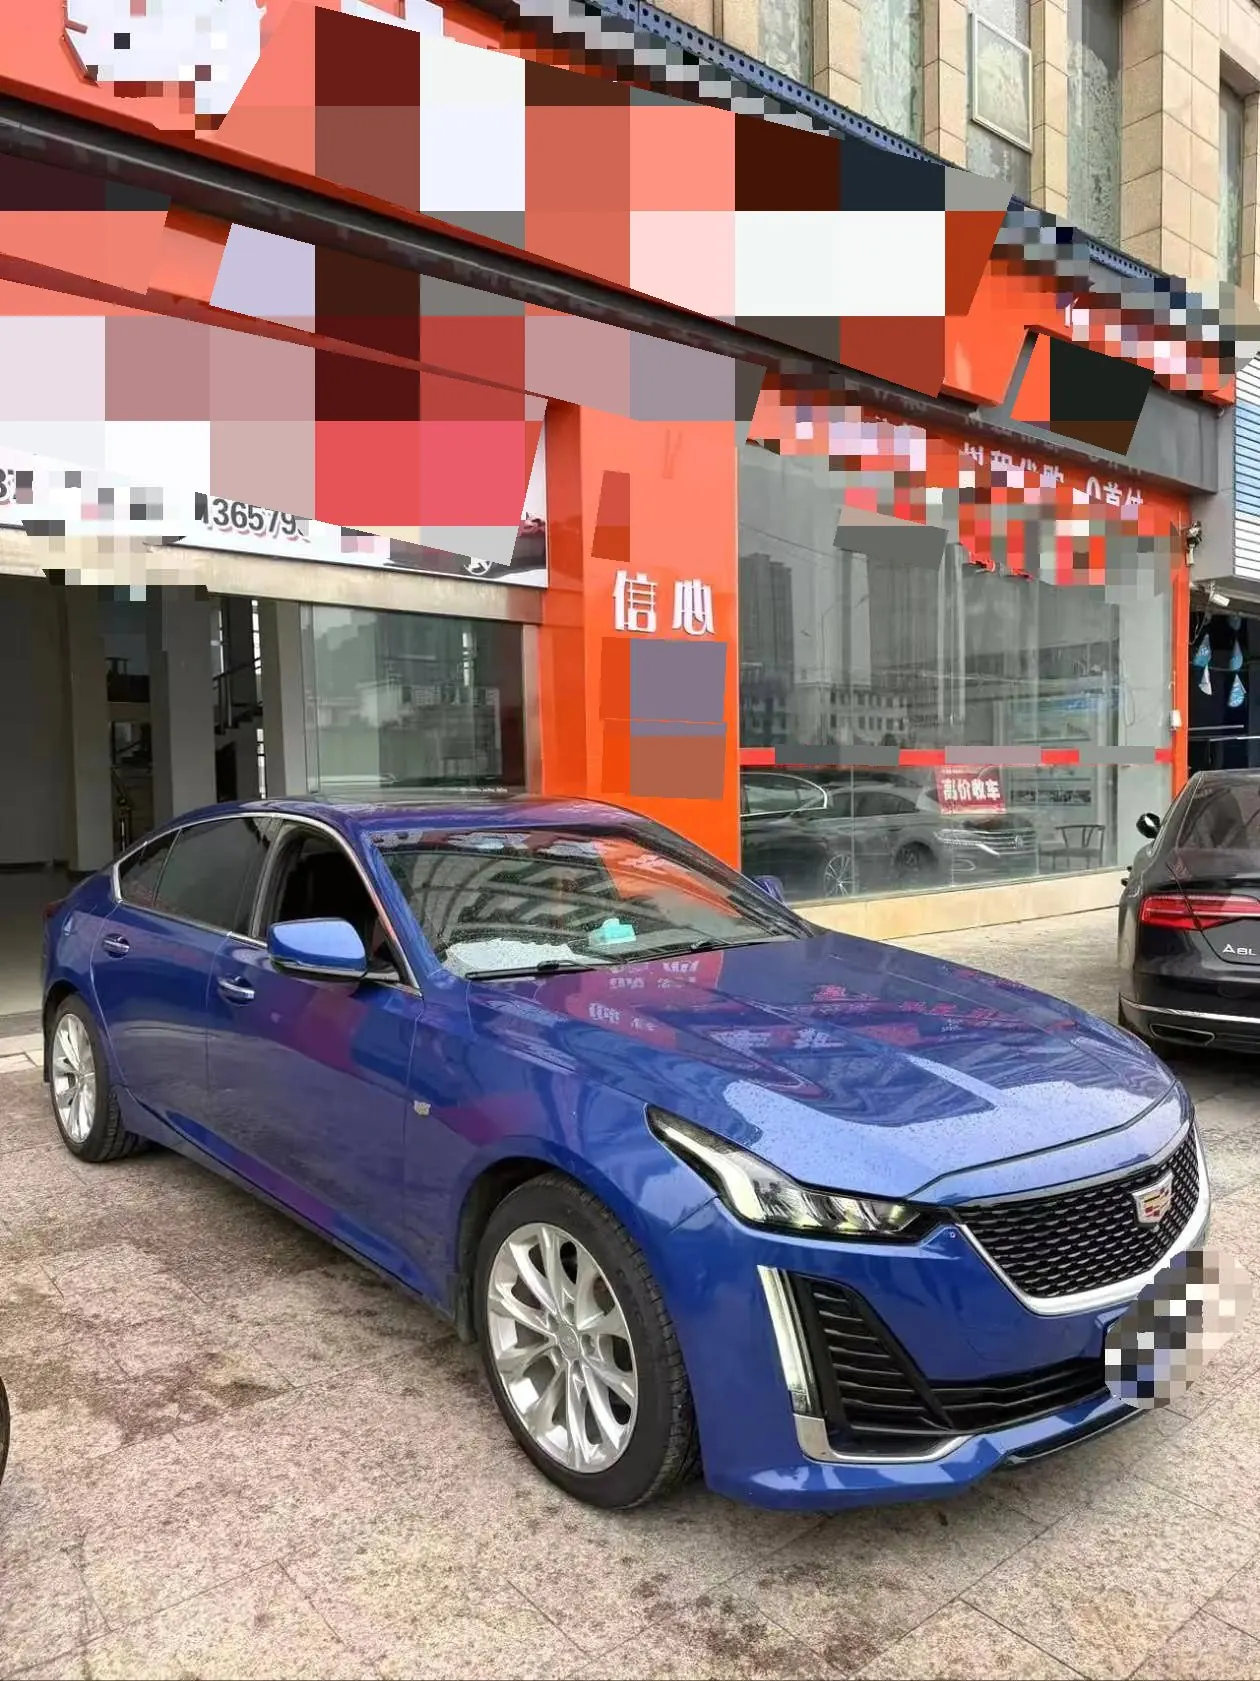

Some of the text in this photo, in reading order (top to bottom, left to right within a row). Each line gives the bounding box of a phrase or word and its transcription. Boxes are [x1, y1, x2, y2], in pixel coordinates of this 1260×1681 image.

[612, 569, 715, 635] 信心
[941, 778, 1001, 801] 高价收车
[1222, 943, 1257, 956] A8L
